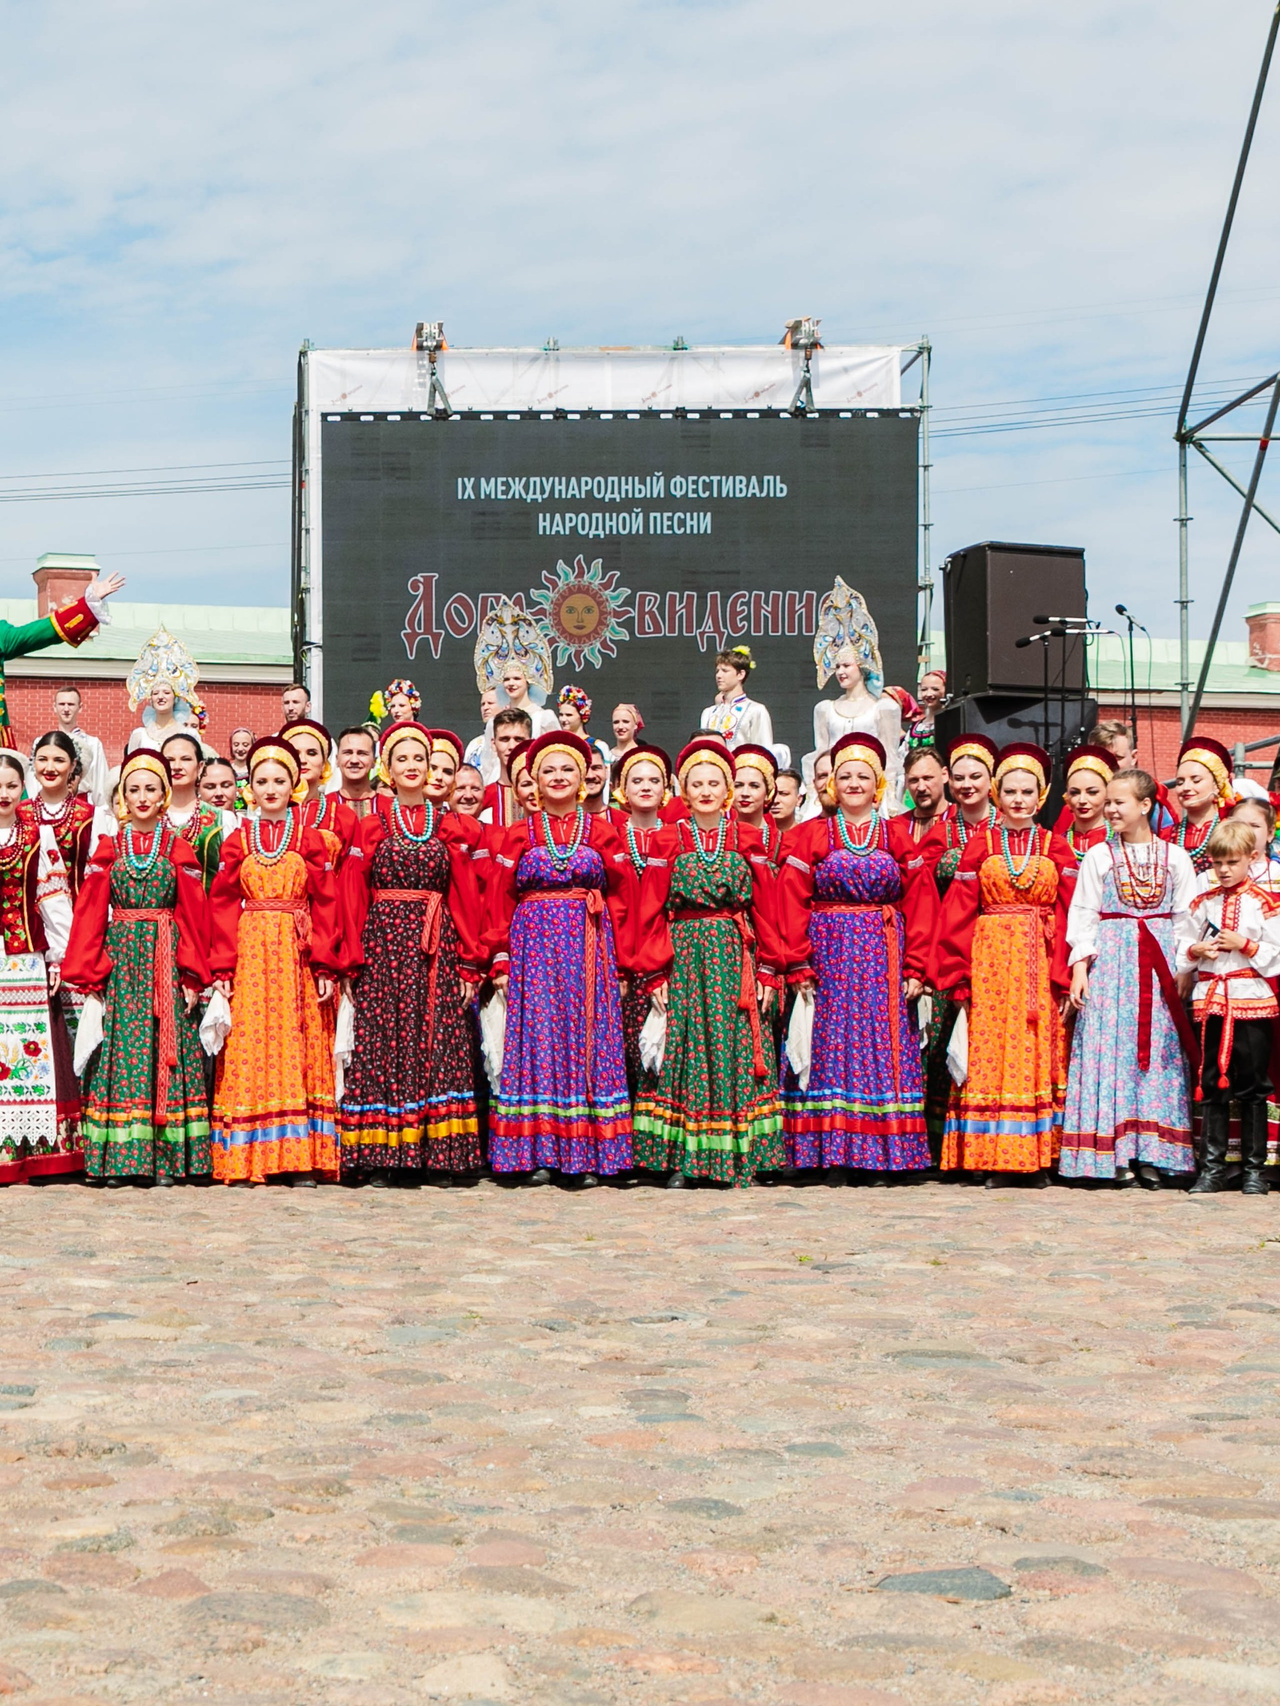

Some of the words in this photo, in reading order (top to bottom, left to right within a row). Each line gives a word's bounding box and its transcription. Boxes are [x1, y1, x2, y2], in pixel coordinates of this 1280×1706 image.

[480, 471, 665, 503] МЕЖДУНАРОДНЫЙ
[669, 475, 788, 499] ФЕСТИВАЛЬ
[537, 508, 644, 539] НАРОДНОЙ
[649, 512, 712, 535] ПЕСНИ
